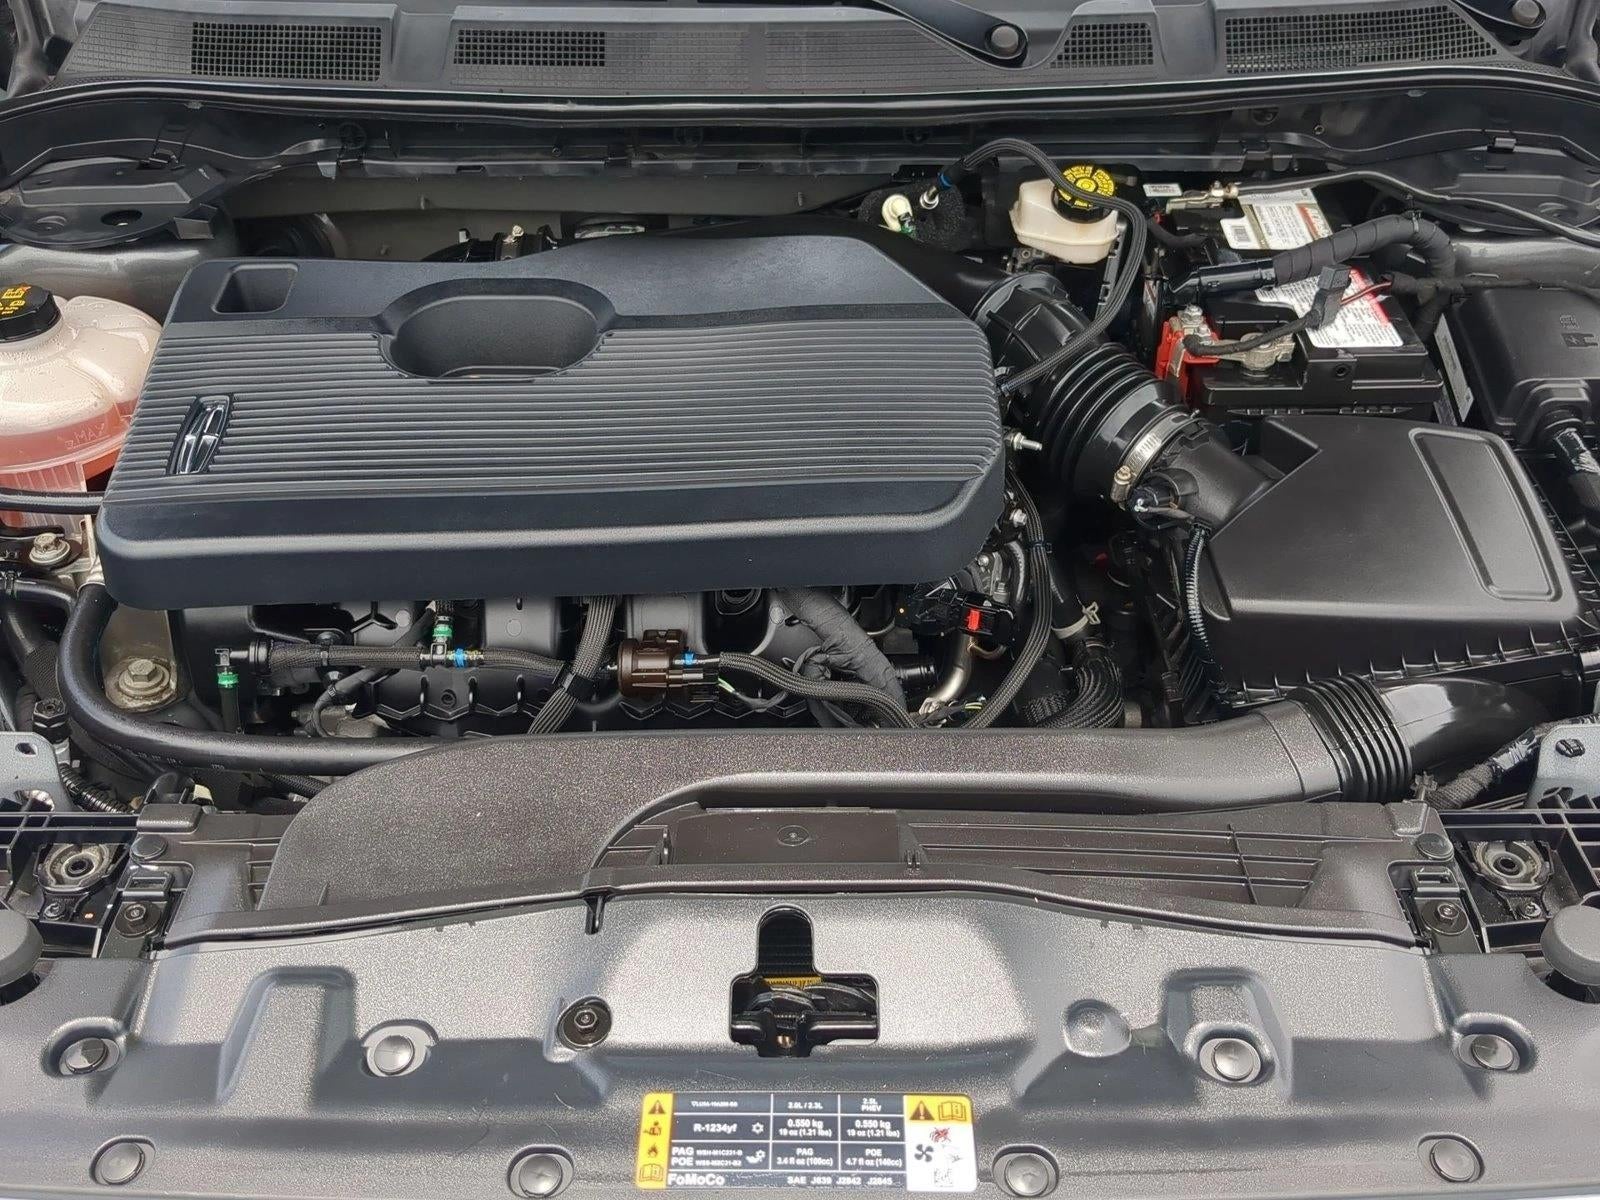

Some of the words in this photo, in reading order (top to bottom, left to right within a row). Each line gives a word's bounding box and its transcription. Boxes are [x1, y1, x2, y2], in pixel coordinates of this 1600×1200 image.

[693, 1123, 738, 1134] R-1234yf
[787, 1119, 811, 1128] 0.550
[812, 1119, 824, 1129] kg
[855, 1120, 878, 1128] 0.550
[880, 1120, 891, 1130] kg
[671, 1147, 694, 1156] PAG
[796, 1148, 814, 1156] PAG
[865, 1149, 883, 1157] POE
[671, 1157, 694, 1166] POE
[845, 1158, 856, 1166] 4.7
[667, 1174, 725, 1186] FoMoCo
[787, 1176, 806, 1184] SAE
